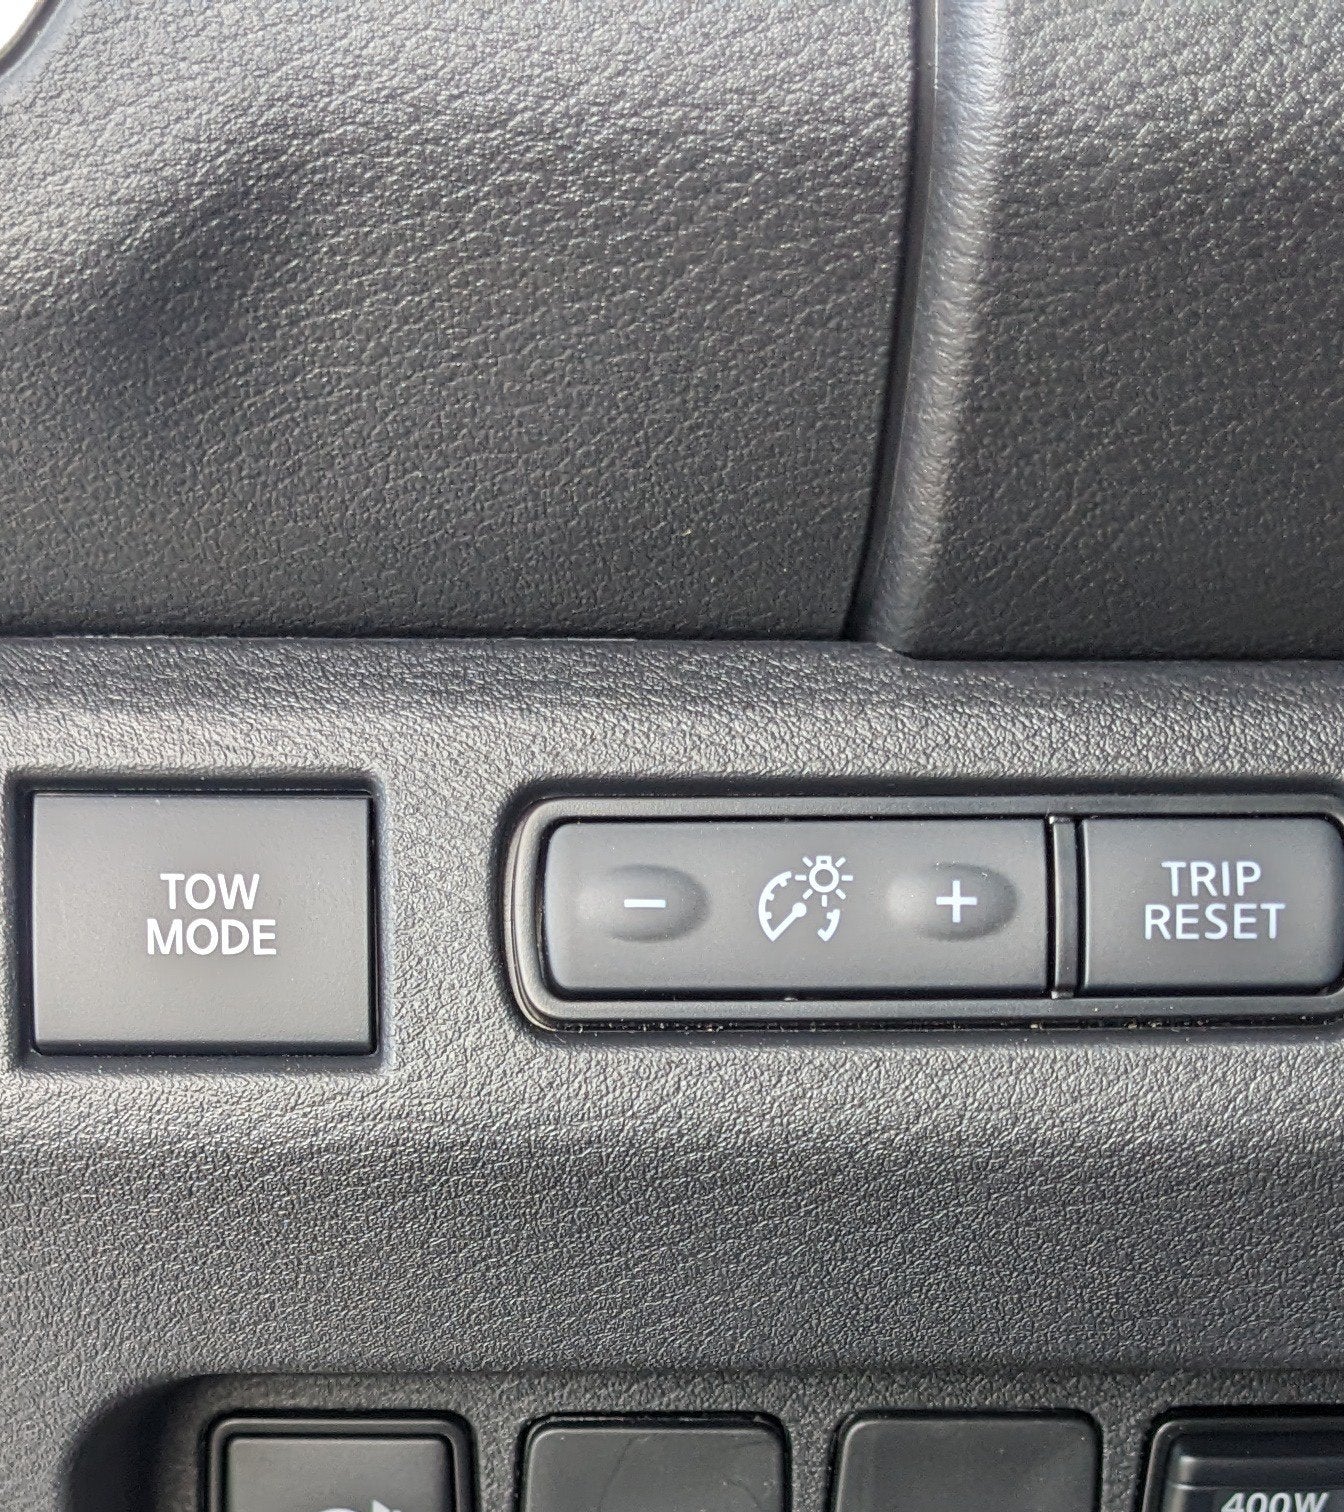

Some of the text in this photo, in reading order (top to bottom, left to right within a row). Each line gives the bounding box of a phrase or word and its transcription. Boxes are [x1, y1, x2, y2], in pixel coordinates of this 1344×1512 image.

[159, 873, 260, 911] TOW
[1160, 860, 1262, 897] TRIP
[146, 917, 277, 956] MODE
[1144, 902, 1287, 940] RESET
